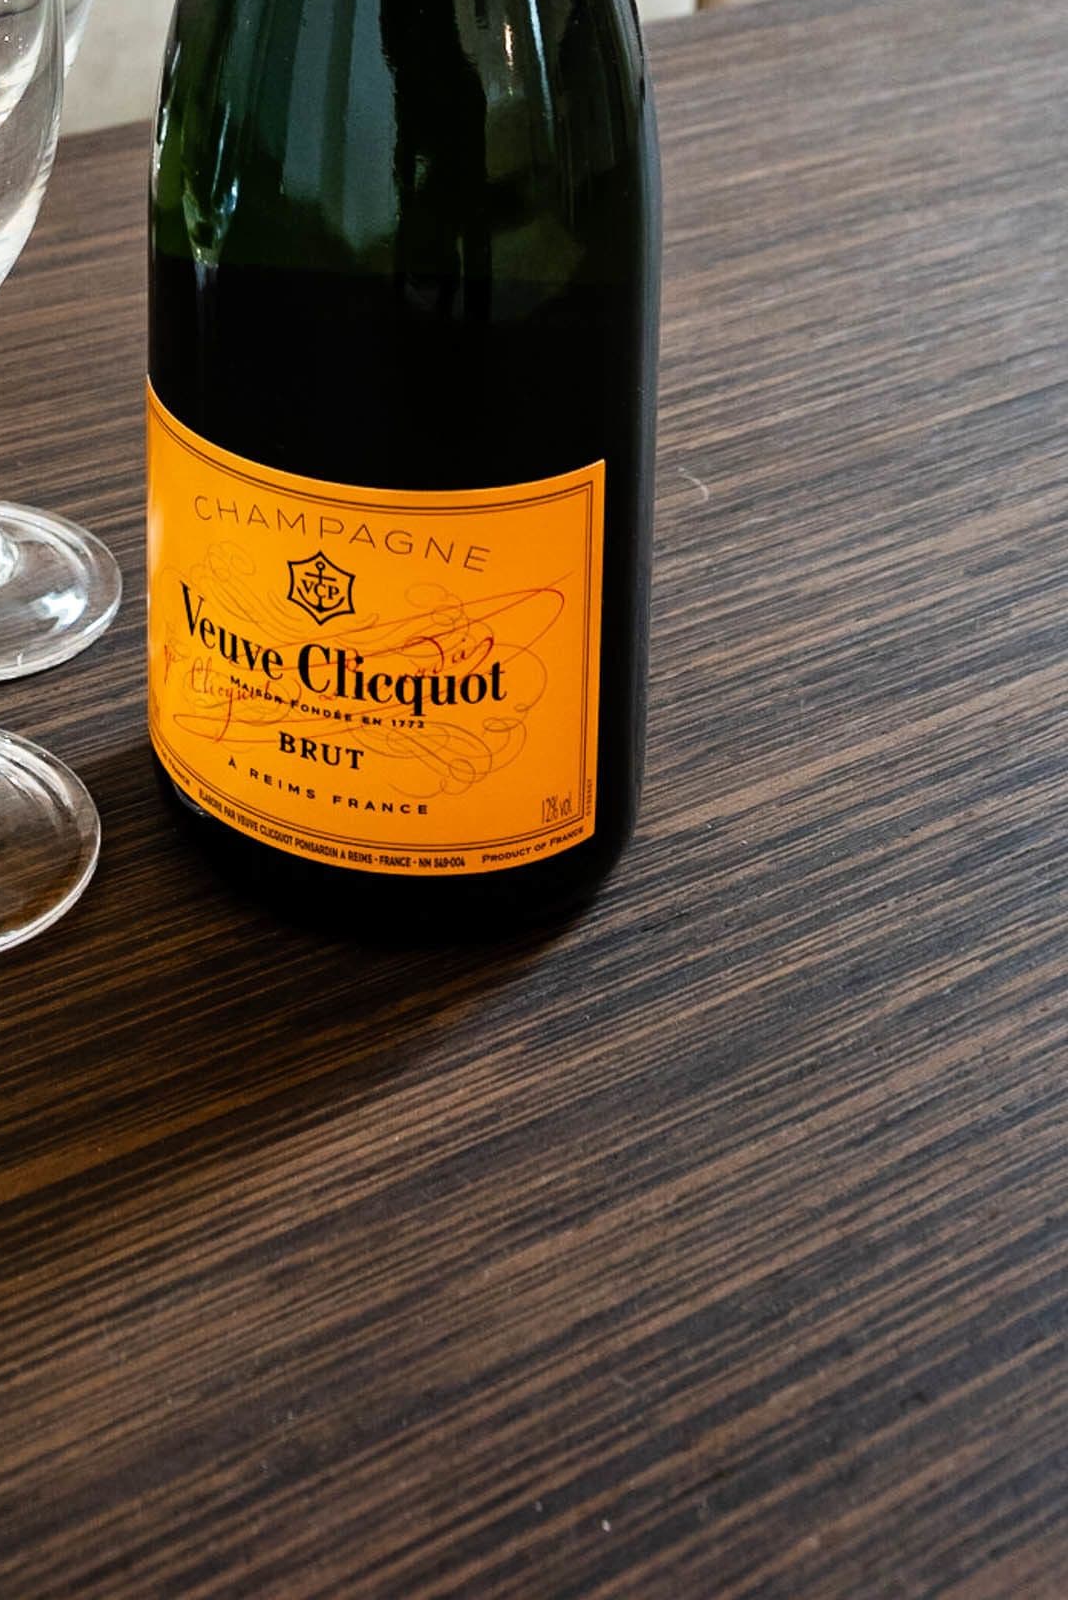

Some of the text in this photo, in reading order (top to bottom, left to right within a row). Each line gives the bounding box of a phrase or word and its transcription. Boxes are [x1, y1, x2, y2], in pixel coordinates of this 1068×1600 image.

[194, 494, 492, 573] CHAMPAGNE
[301, 578, 340, 601] VCP
[179, 579, 284, 681] Veuve
[297, 642, 508, 717] Clicquot
[230, 675, 284, 705] MAISON
[361, 715, 382, 726] EN
[278, 730, 365, 770] BRUT
[248, 766, 317, 800] REIMS
[332, 795, 429, 816] FRANCE
[379, 854, 411, 868] FRANCE
[482, 825, 585, 864] PRODUCT OF FRANCE
